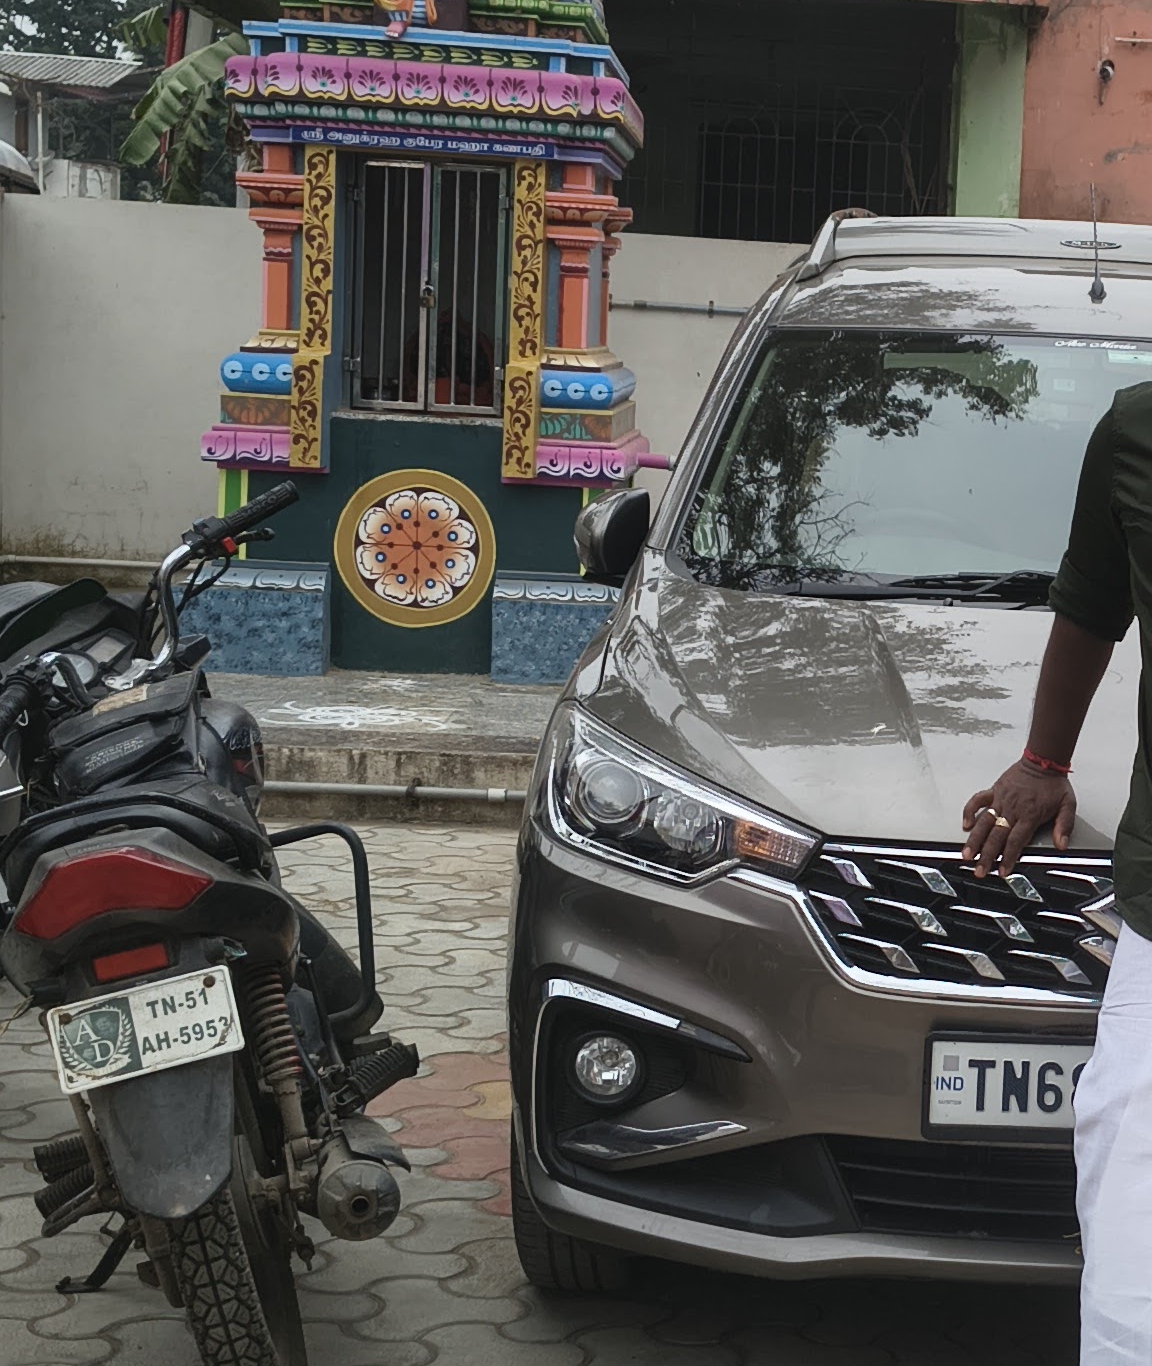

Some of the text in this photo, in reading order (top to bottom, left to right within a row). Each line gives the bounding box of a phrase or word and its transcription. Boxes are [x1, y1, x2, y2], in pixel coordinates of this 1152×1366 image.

[301, 128, 324, 141] ஸ்ரீ
[403, 136, 444, 149] குபேர
[447, 140, 490, 152] மஹா
[493, 143, 546, 156] கணபதி
[146, 987, 209, 1018] TN-51
[935, 1076, 964, 1091] IND
